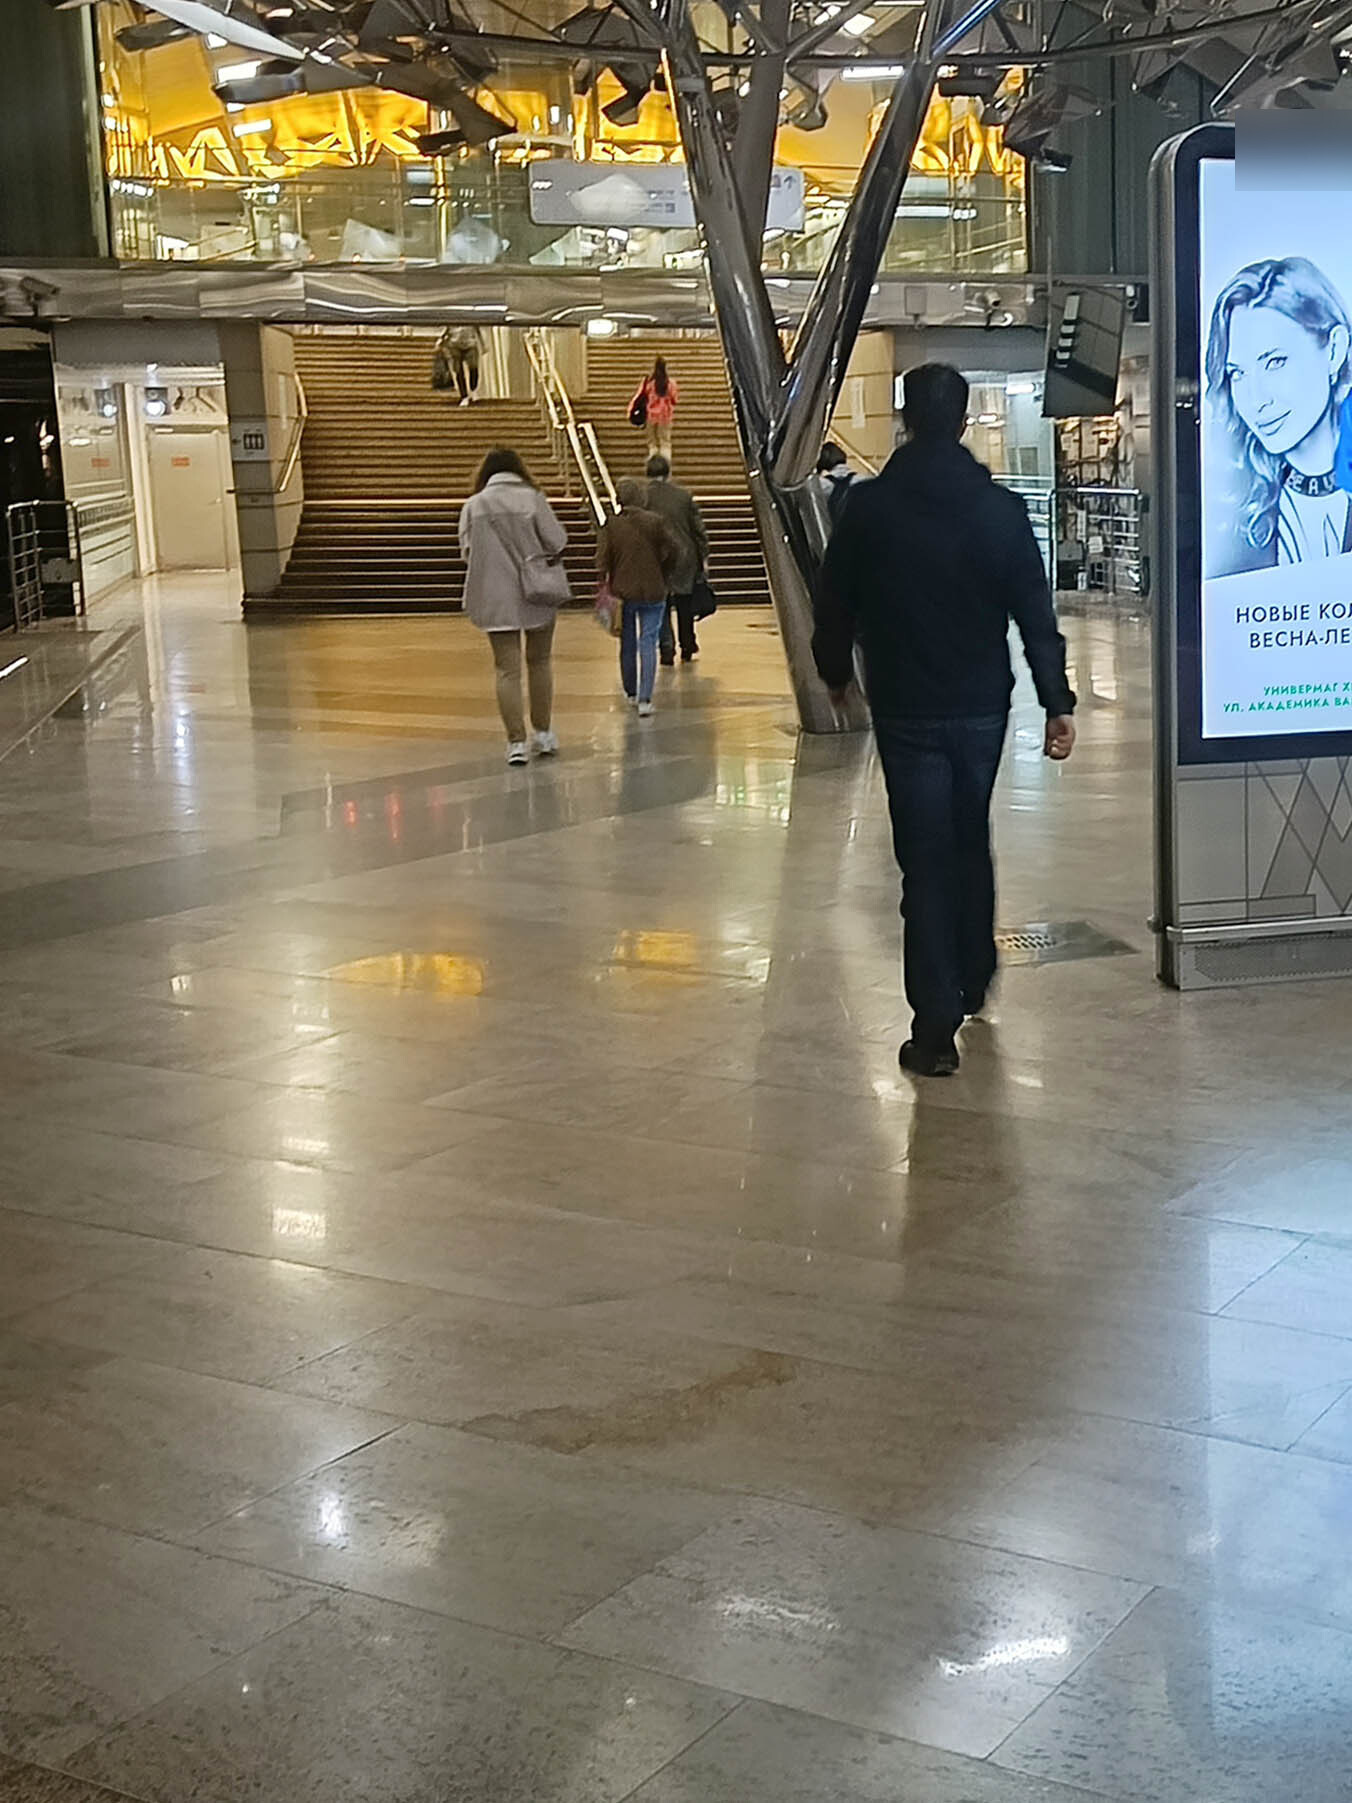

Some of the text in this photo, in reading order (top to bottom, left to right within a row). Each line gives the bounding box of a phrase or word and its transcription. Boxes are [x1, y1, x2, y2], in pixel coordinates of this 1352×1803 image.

[1235, 604, 1311, 624] НОВЫЕ
[1263, 682, 1338, 697] УНИВЕРМАГ
[1248, 697, 1330, 712] АКАДЕМИКА
